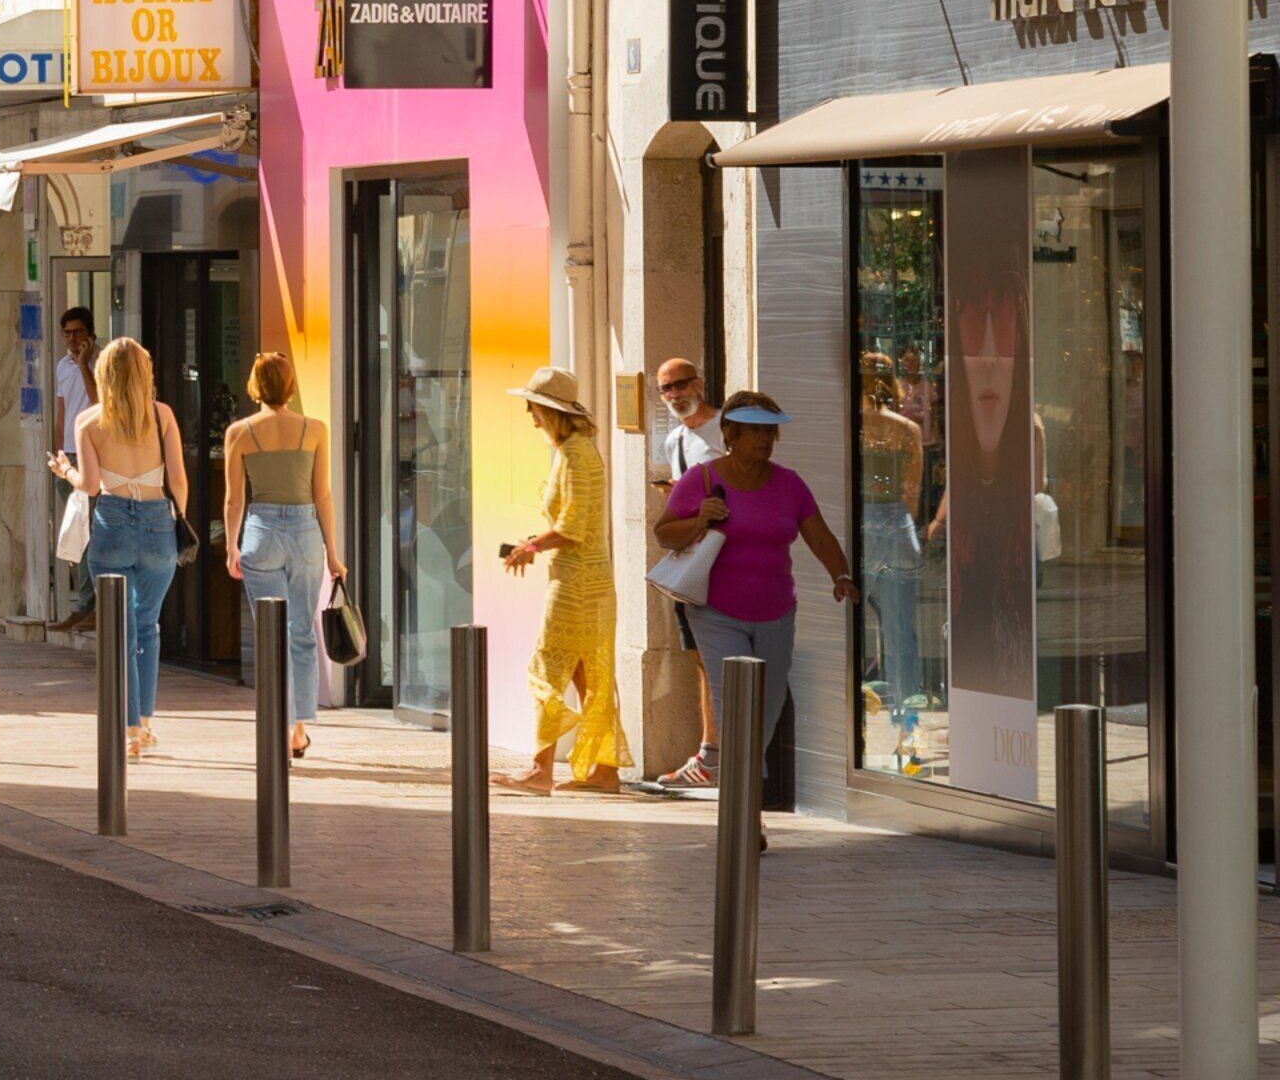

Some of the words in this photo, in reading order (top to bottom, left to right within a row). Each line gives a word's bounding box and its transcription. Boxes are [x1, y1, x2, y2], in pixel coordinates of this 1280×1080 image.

[131, 7, 178, 44] OR
[91, 47, 221, 85] BIJOUX
[993, 726, 1033, 767] DIOR
